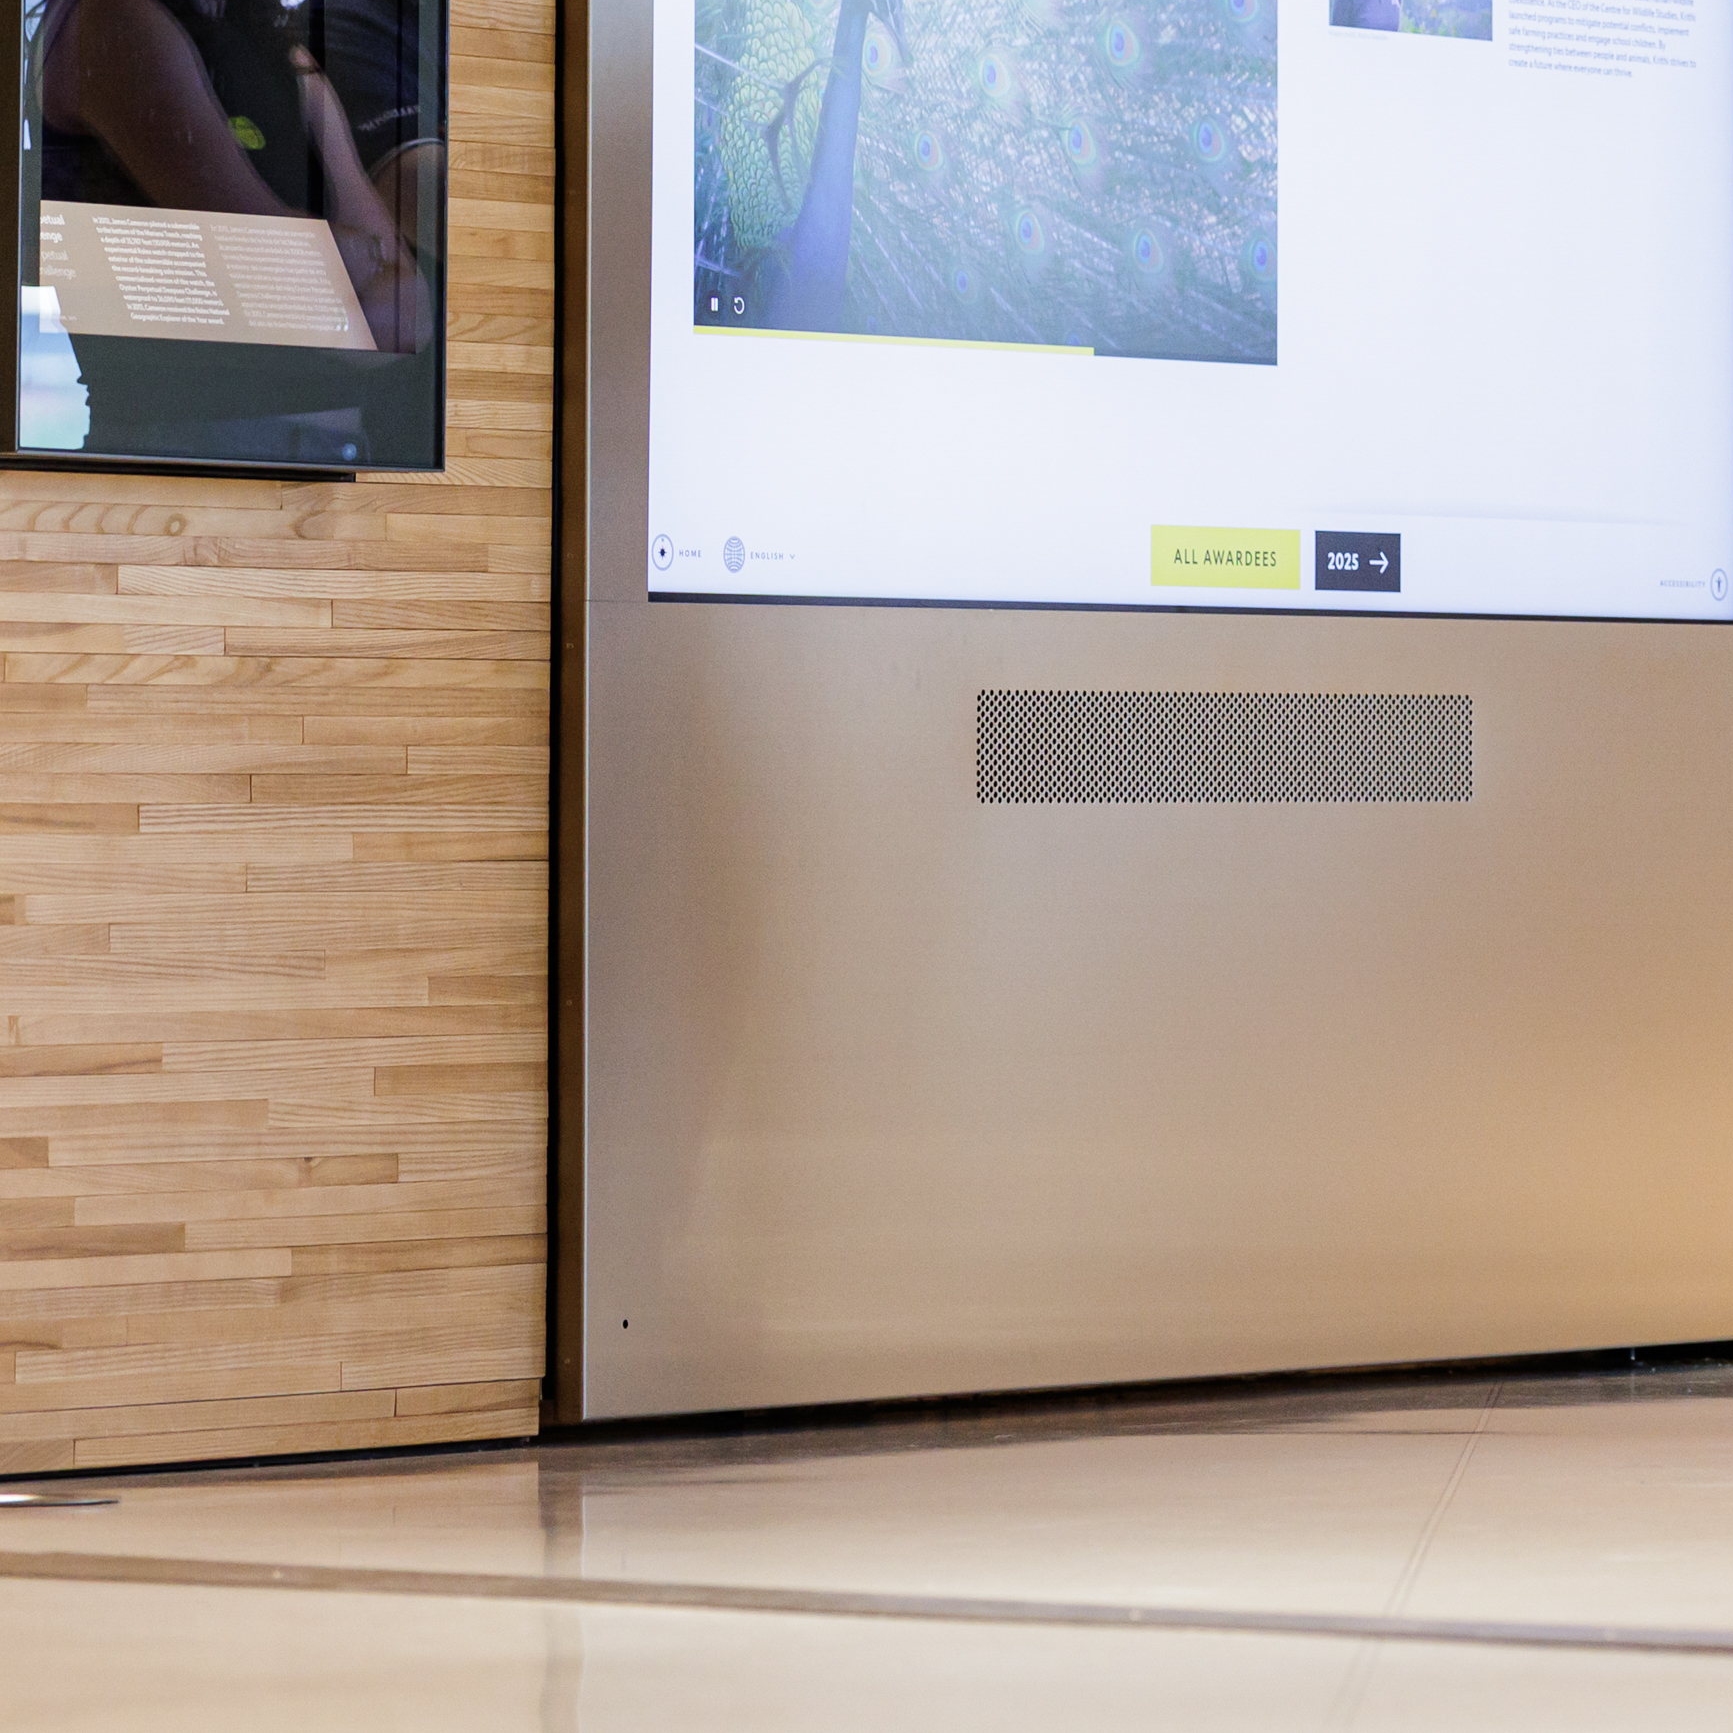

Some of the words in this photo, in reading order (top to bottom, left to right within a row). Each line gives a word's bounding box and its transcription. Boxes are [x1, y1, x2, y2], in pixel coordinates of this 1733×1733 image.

[40, 214, 66, 225] etual
[1174, 549, 1198, 564] ALL
[1204, 550, 1276, 567] AWARDEES
[1328, 552, 1358, 570] 2025
